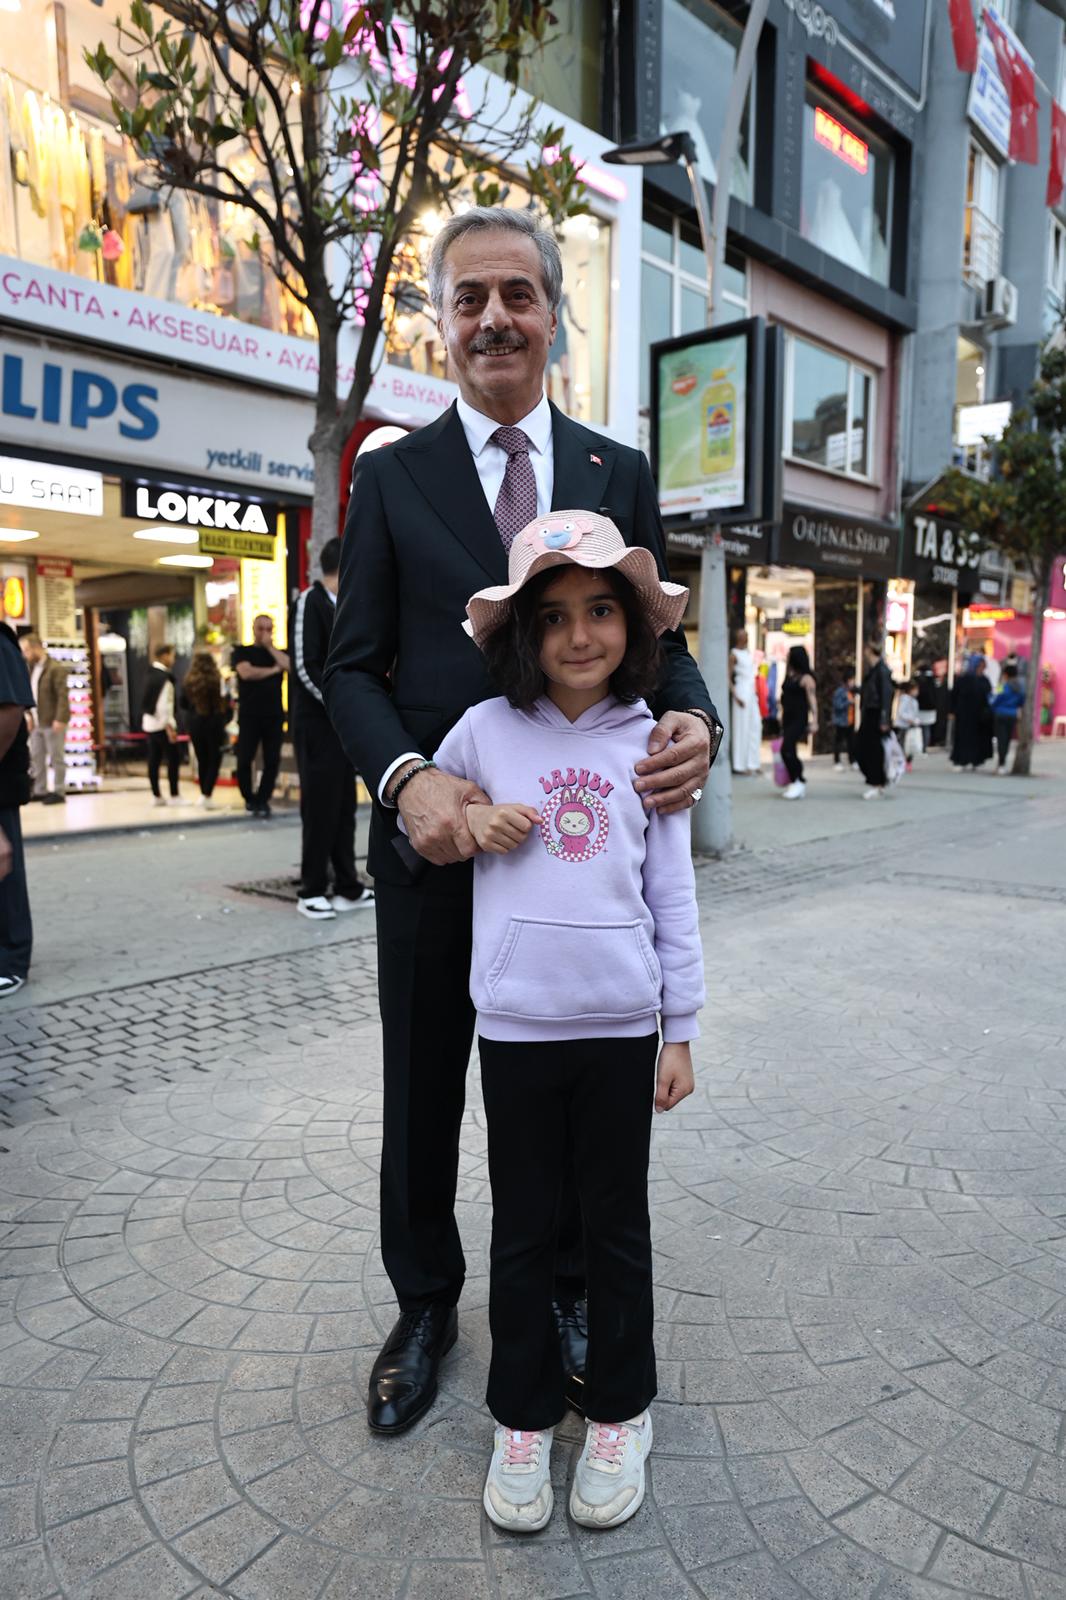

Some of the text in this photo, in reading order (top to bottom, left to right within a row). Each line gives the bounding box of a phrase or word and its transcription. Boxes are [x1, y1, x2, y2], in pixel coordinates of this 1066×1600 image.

[2, 273, 104, 319] ÇANTA
[127, 307, 259, 358] AKSESUAR
[2, 354, 159, 441] LIPS
[207, 447, 262, 472] yetkili
[30, 479, 93, 507] SAAT
[136, 487, 269, 533] LOKKA
[914, 516, 938, 560] TA
[940, 529, 955, 564] &
